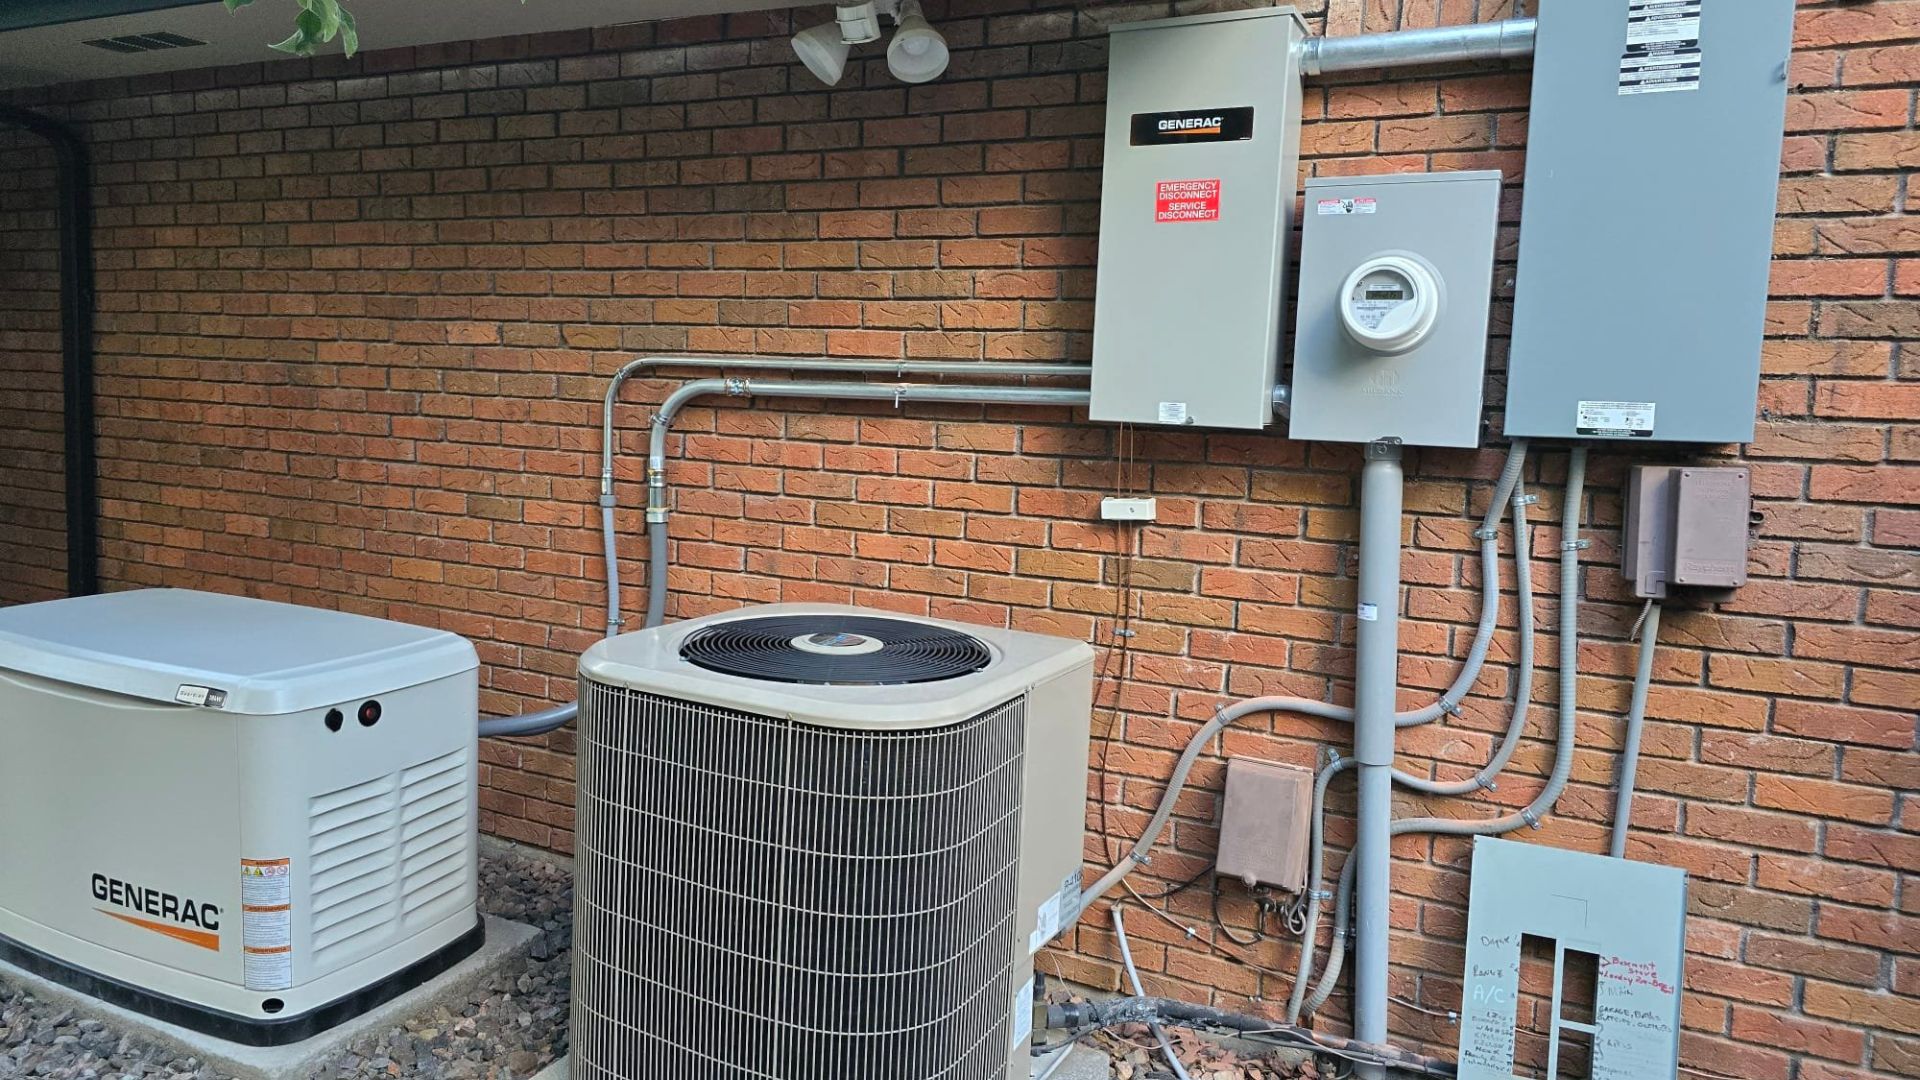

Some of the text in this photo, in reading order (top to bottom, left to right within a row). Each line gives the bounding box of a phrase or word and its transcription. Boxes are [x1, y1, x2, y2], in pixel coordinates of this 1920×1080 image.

[1158, 117, 1222, 130] GENERAC
[1160, 181, 1217, 192] EMERGENCY
[1159, 190, 1217, 200] DISCONNECT
[1168, 201, 1207, 211] SERVICE
[1158, 209, 1217, 220] DISCONNECT
[92, 873, 219, 931] GENERAC
[1473, 984, 1505, 1004] A/C
